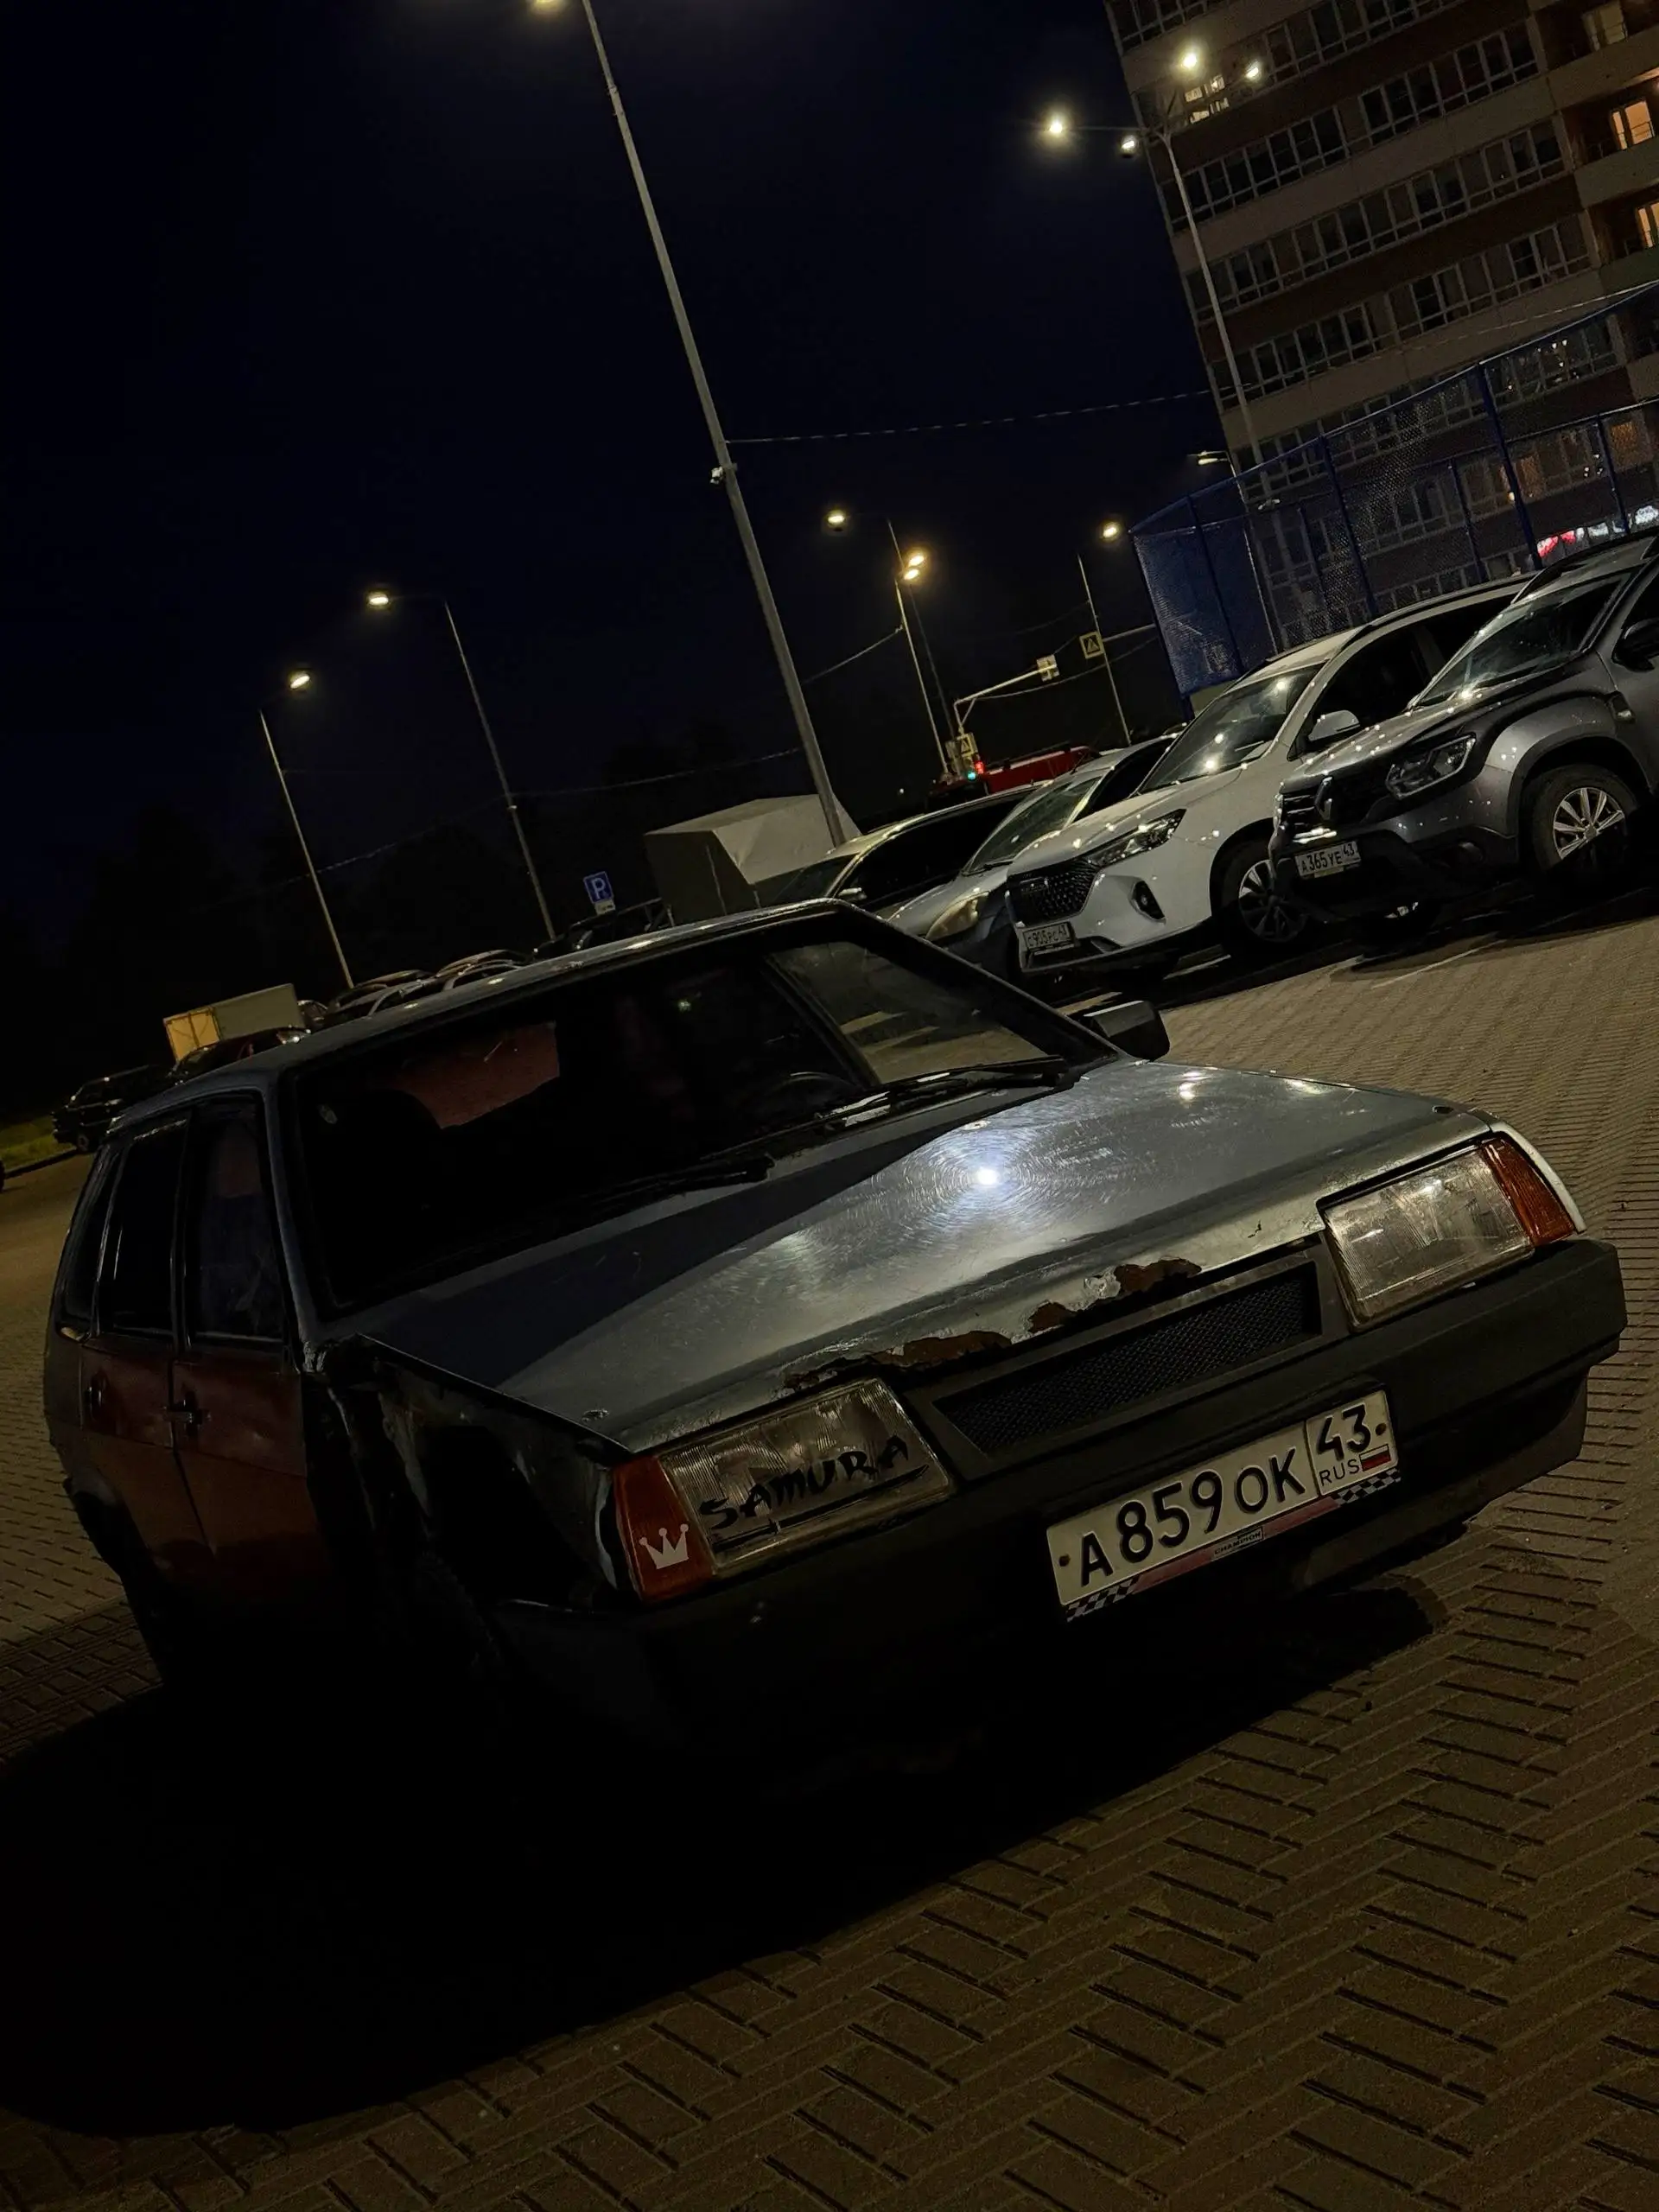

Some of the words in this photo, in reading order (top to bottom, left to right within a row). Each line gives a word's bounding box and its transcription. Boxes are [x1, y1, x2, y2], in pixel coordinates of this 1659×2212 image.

[591, 877, 606, 899] P
[1320, 1462, 1360, 1486] RUS
[1080, 1447, 1306, 1586] А859ОК
[1316, 1404, 1371, 1460] 43
